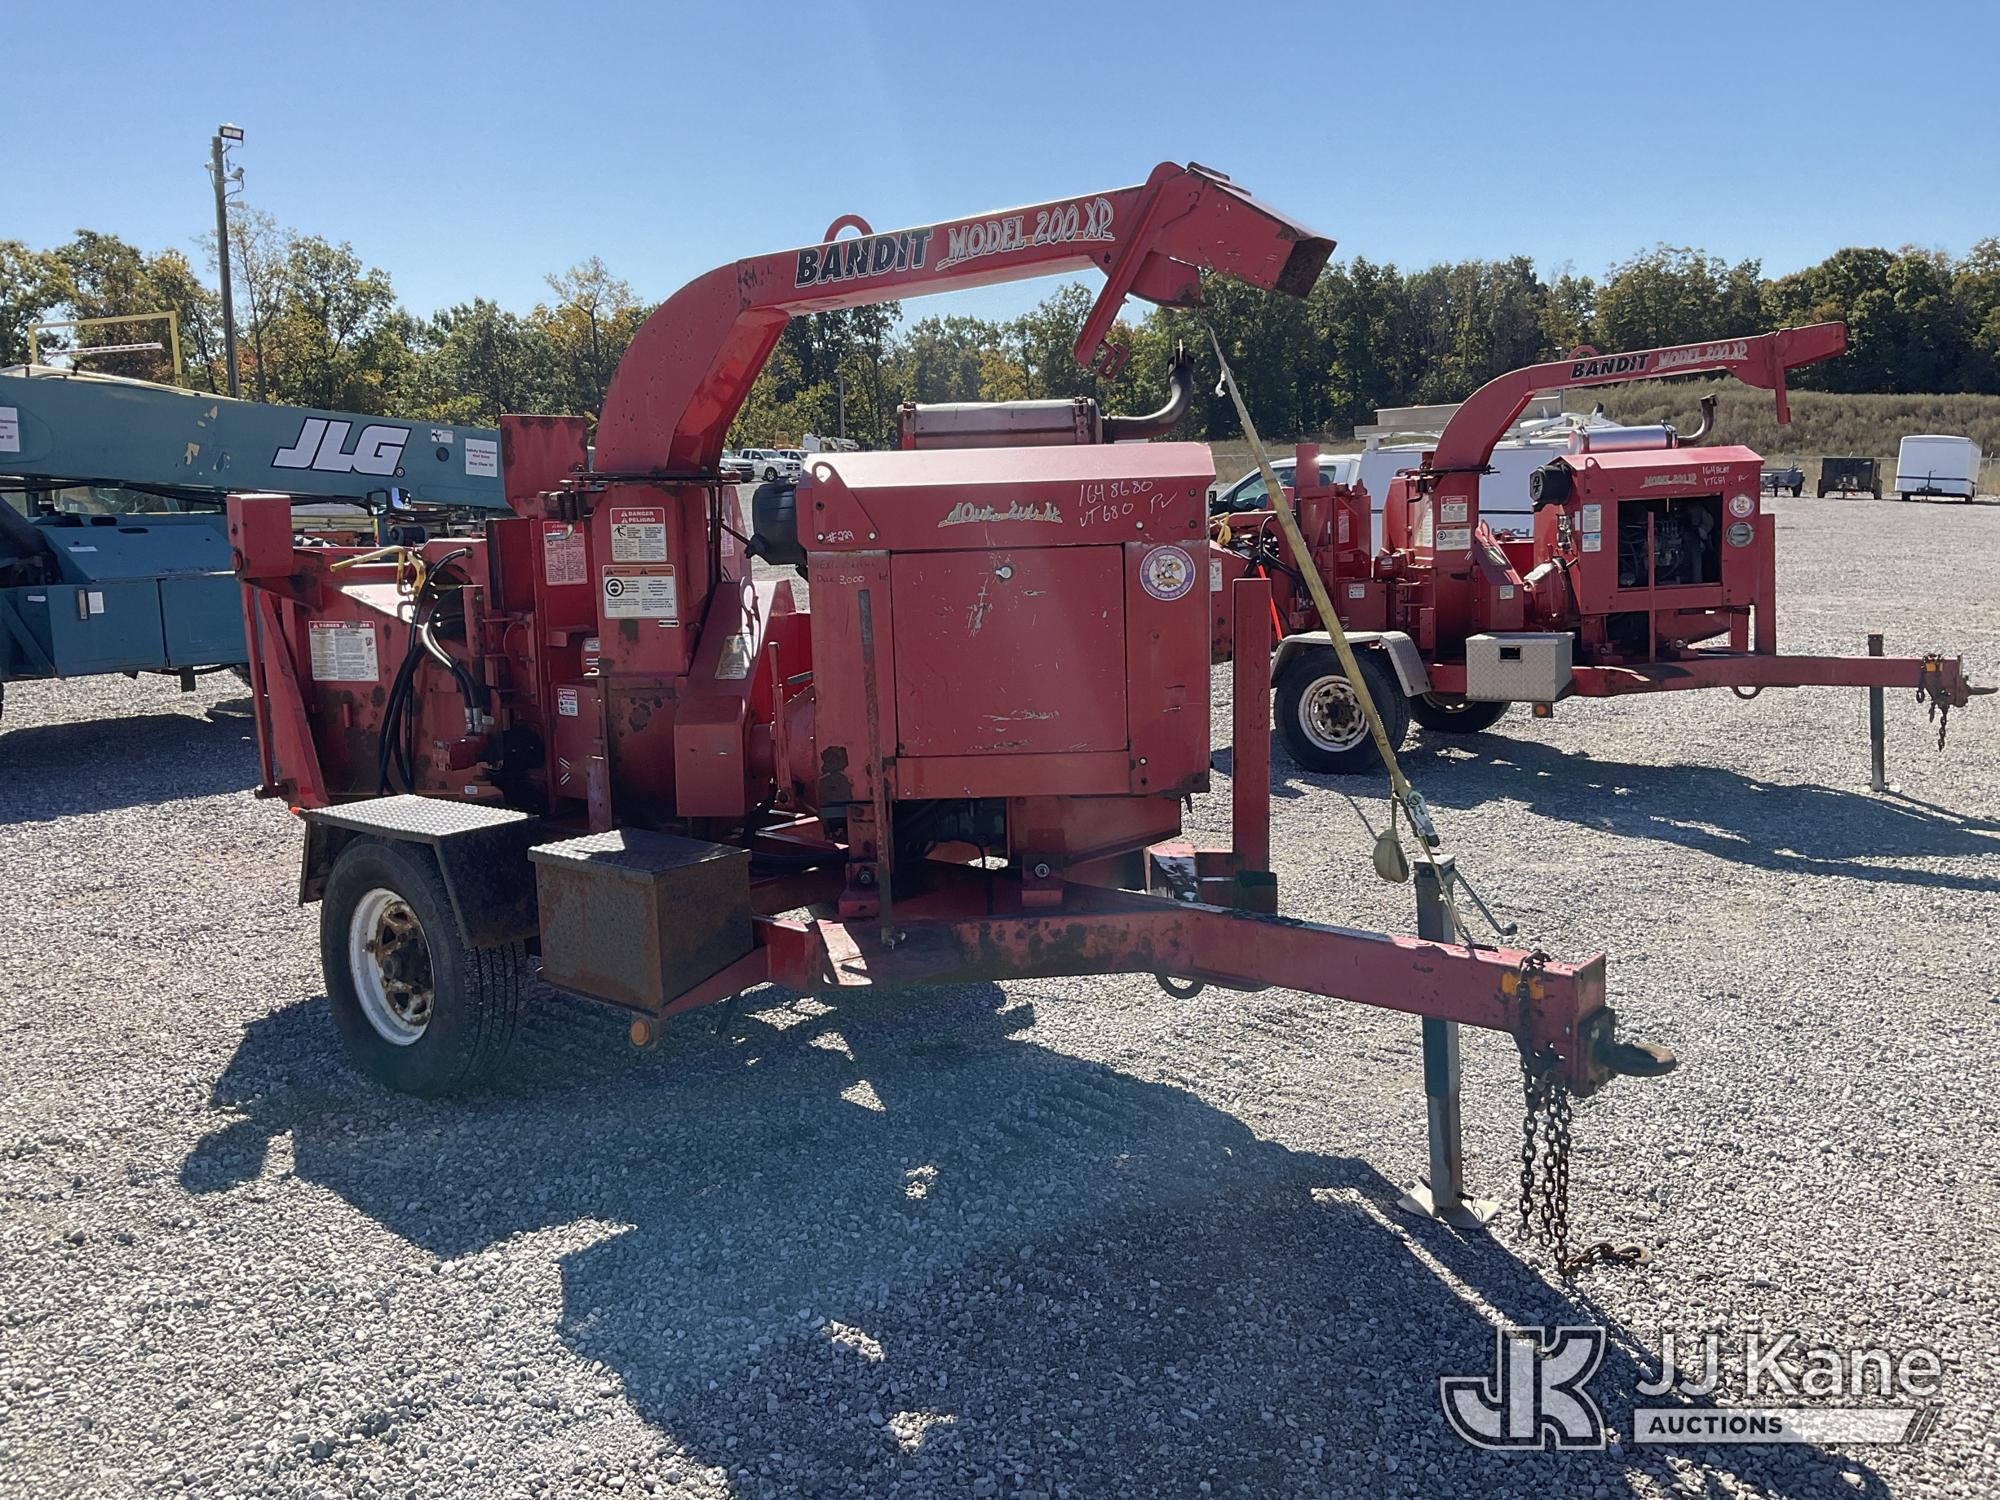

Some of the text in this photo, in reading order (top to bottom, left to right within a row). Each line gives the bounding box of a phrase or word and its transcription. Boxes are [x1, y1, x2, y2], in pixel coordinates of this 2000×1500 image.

[794, 197, 1116, 288] BANDIT MODEL 200 XP
[1571, 353, 1648, 379] BANDIT
[1659, 349, 1700, 367] MODEL
[1731, 341, 1748, 359] XP
[271, 416, 412, 477] JLG
